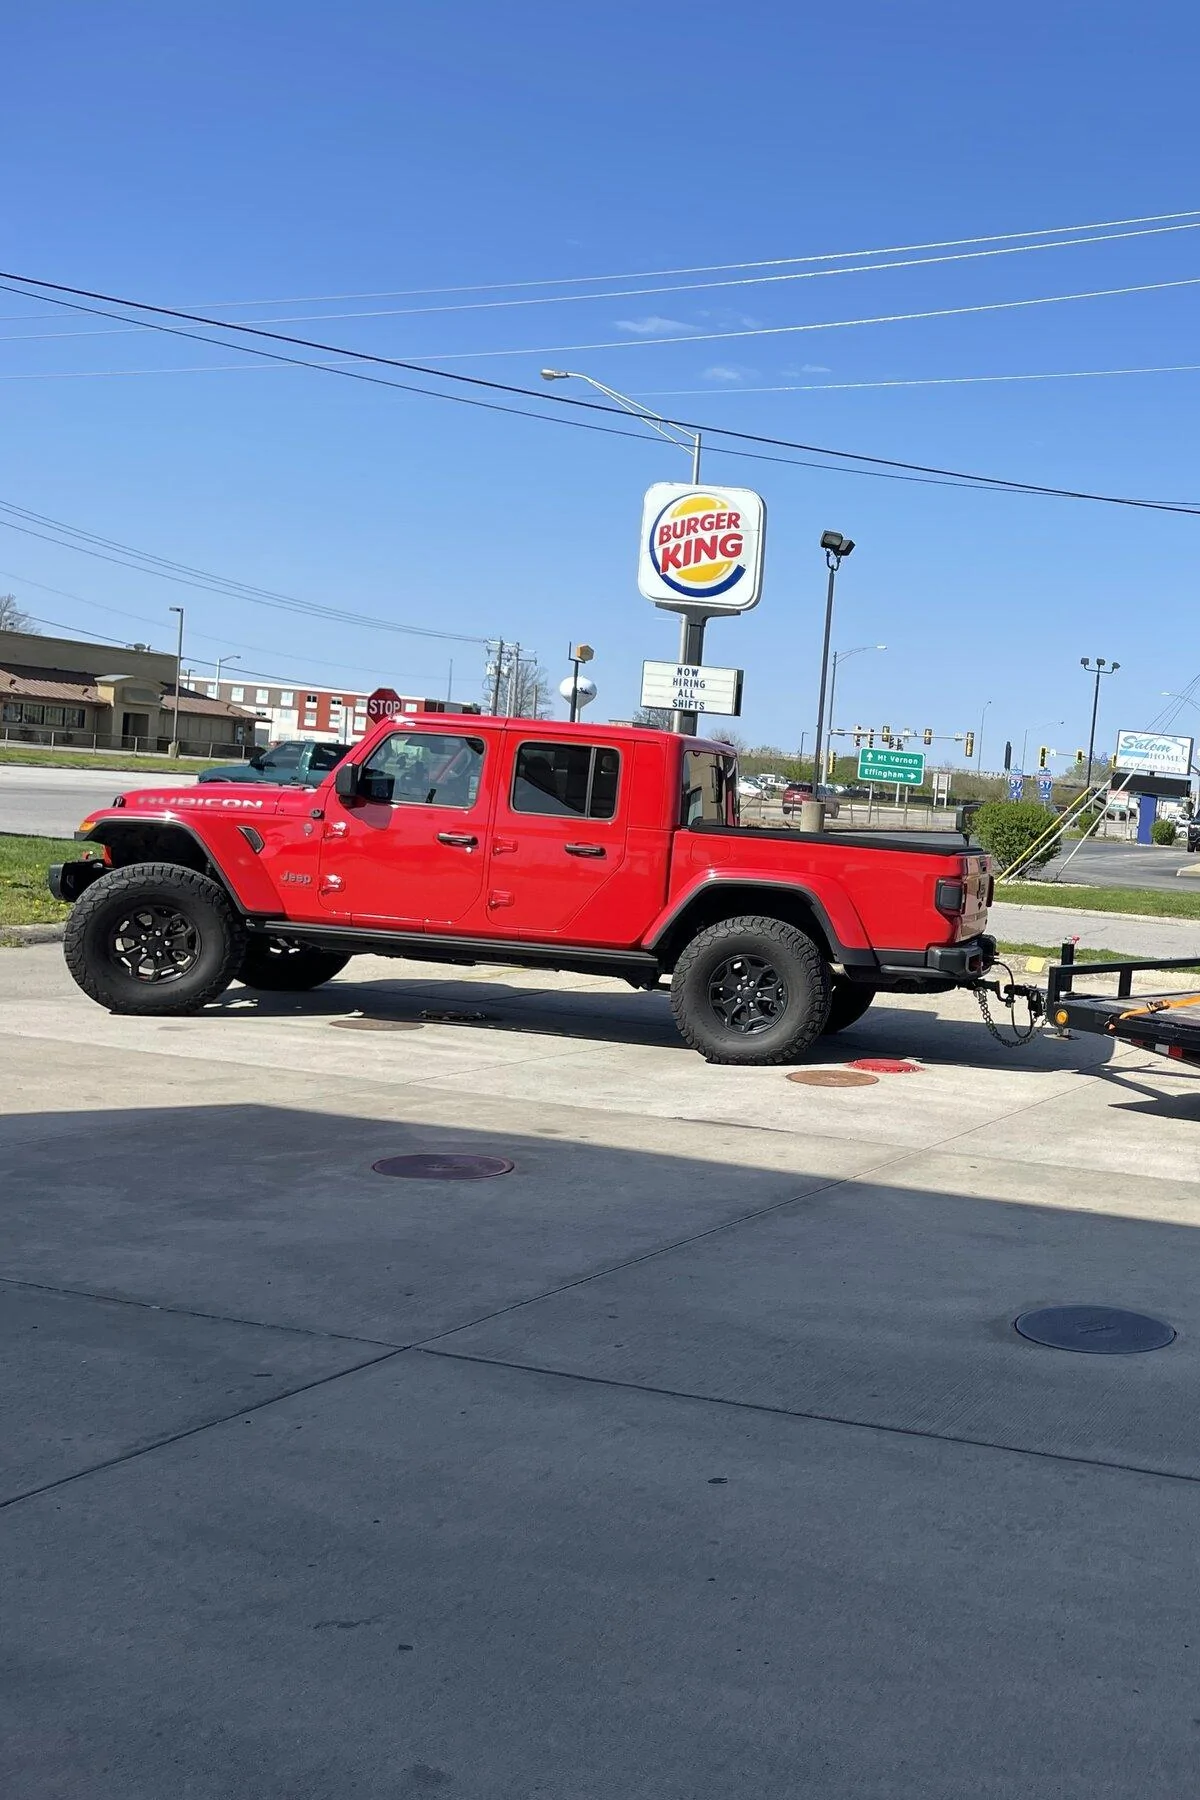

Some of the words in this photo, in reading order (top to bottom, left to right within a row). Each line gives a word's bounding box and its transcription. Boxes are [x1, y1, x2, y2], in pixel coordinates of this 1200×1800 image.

[659, 512, 741, 546] BURGER
[662, 533, 743, 573] KING
[677, 667, 699, 677] NOW
[673, 678, 706, 689] HIRING
[678, 689, 695, 698] ALL
[369, 700, 400, 715] STOP
[672, 699, 705, 710] SHIFTS
[1121, 735, 1172, 753] Salem
[877, 754, 887, 762] Mt
[890, 756, 918, 765] Vernon
[1150, 752, 1187, 762] HOMES
[864, 769, 904, 779] Effingham
[1011, 780, 1021, 788] 57
[1040, 781, 1050, 789] 57
[138, 797, 263, 809] RUBICON
[281, 870, 312, 885] Jeep
